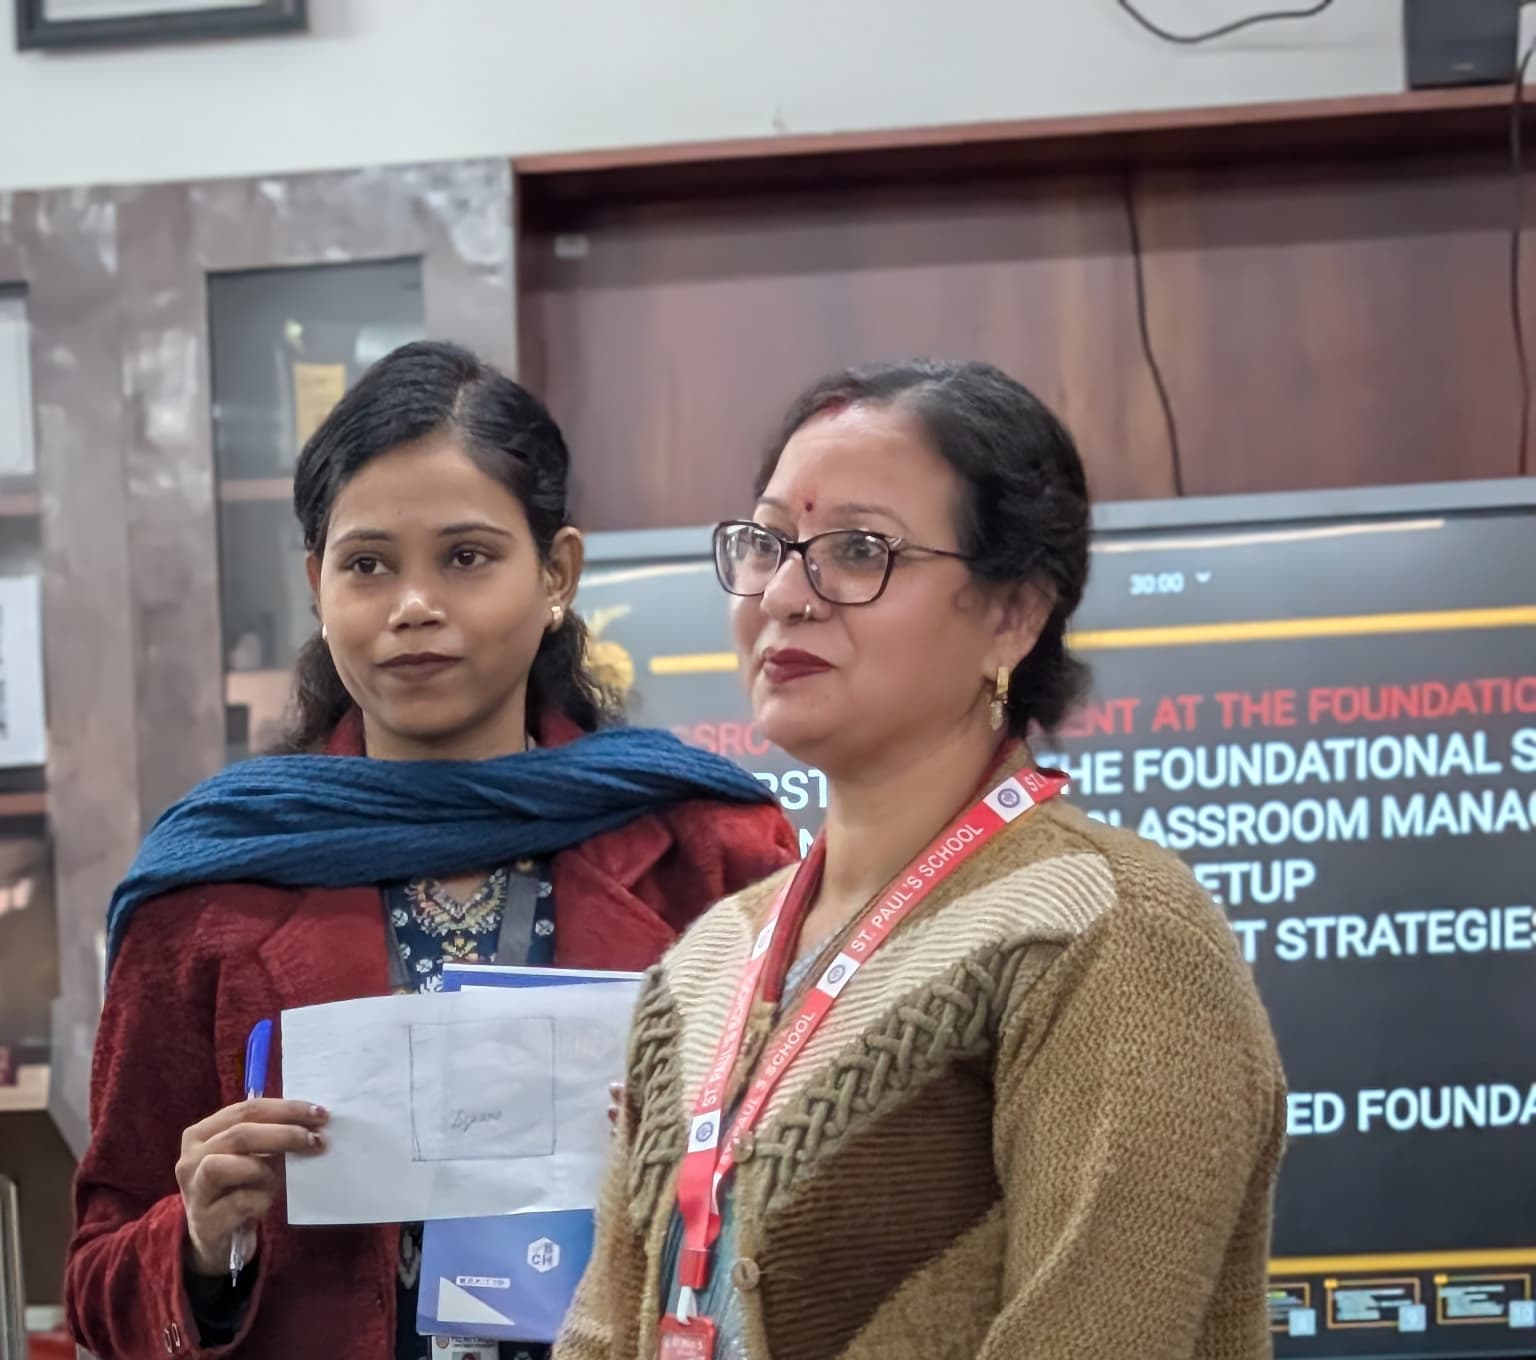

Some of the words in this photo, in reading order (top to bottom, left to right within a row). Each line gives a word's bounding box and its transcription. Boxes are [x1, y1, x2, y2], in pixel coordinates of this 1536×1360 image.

[1151, 694, 1204, 733] AT
[1215, 688, 1297, 730] THE
[1133, 730, 1503, 795] FOUNDATIONAL
[870, 875, 924, 929] PAUL'S
[918, 822, 984, 878] SCHOOL
[764, 1011, 816, 1076] SCHOOL
[1286, 1091, 1346, 1136] ED
